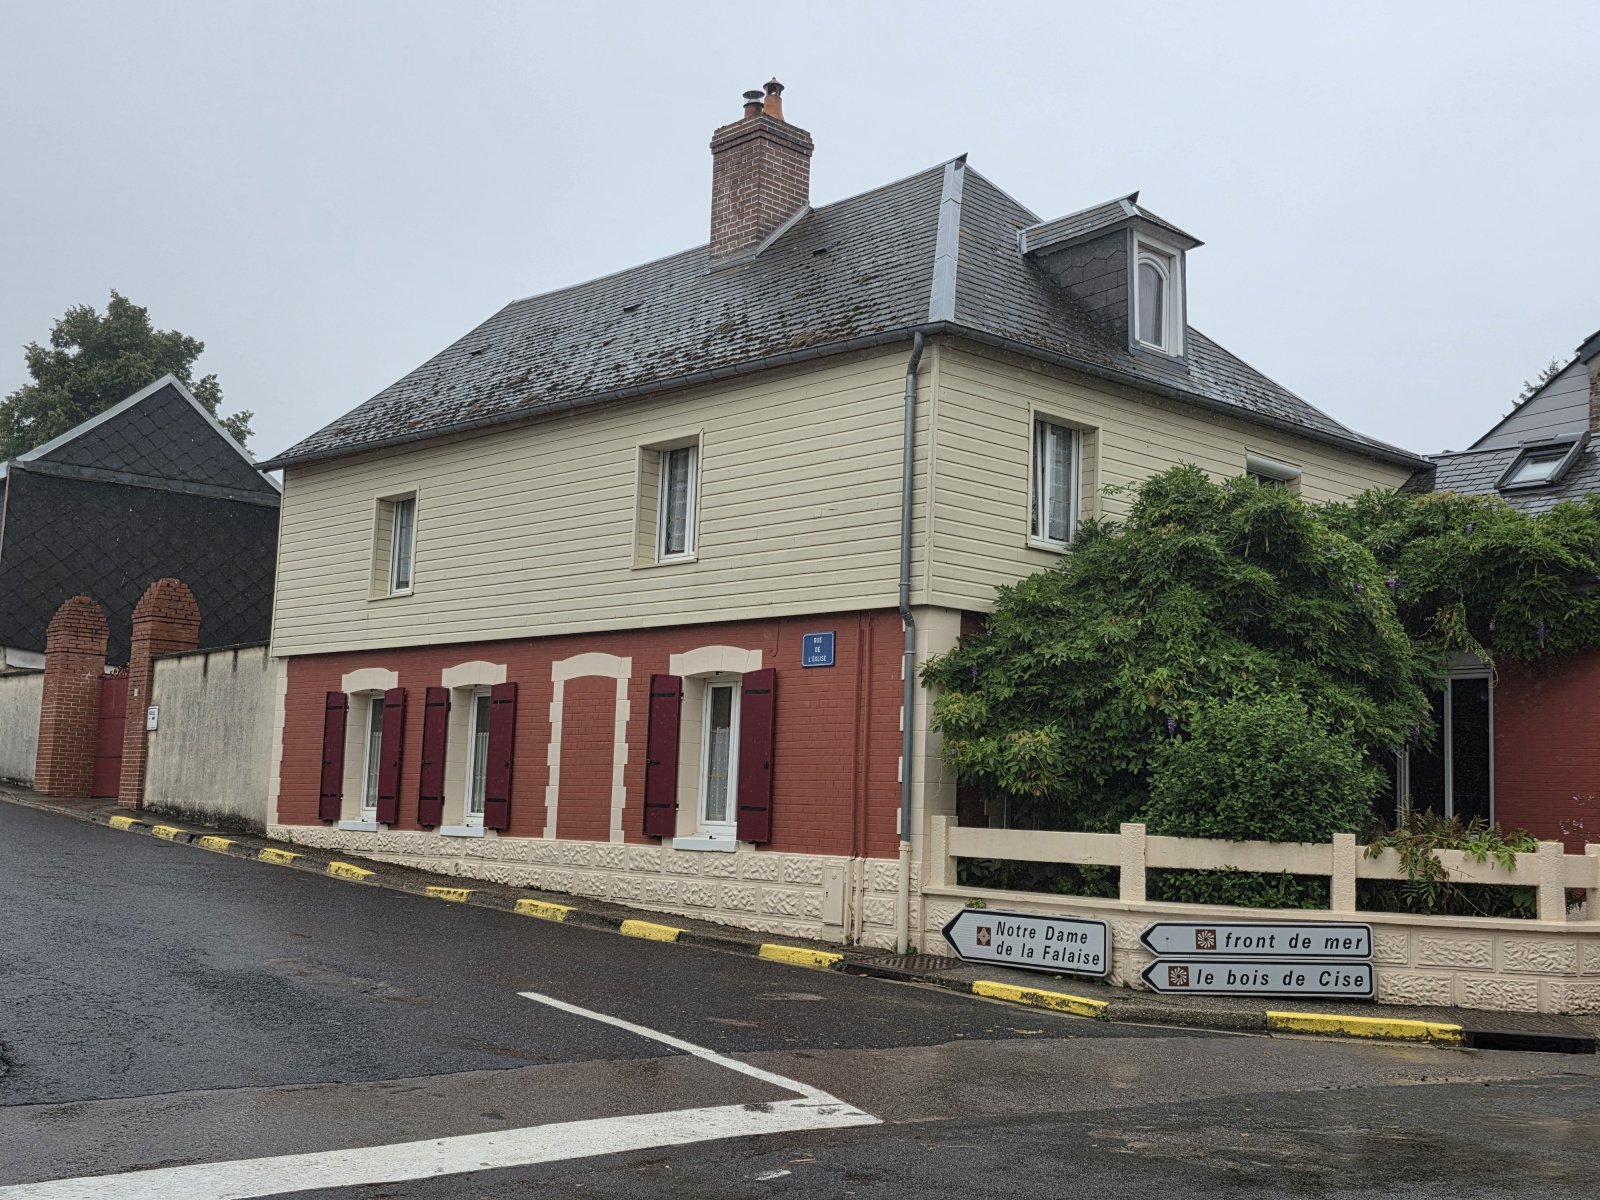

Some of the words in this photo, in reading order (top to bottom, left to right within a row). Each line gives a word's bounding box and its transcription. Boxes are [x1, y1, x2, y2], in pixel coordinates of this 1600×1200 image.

[996, 921, 1036, 939] Notre
[1045, 926, 1088, 944] Dame
[1225, 932, 1276, 948] front
[1288, 933, 1312, 949] de
[1324, 936, 1363, 950] mer
[996, 941, 1013, 956] de
[1021, 943, 1034, 959] la
[1043, 946, 1100, 966] Falaise
[1196, 969, 1214, 985] le
[1227, 969, 1269, 986] bois
[1282, 970, 1306, 986] de
[1318, 971, 1364, 987] Cise
